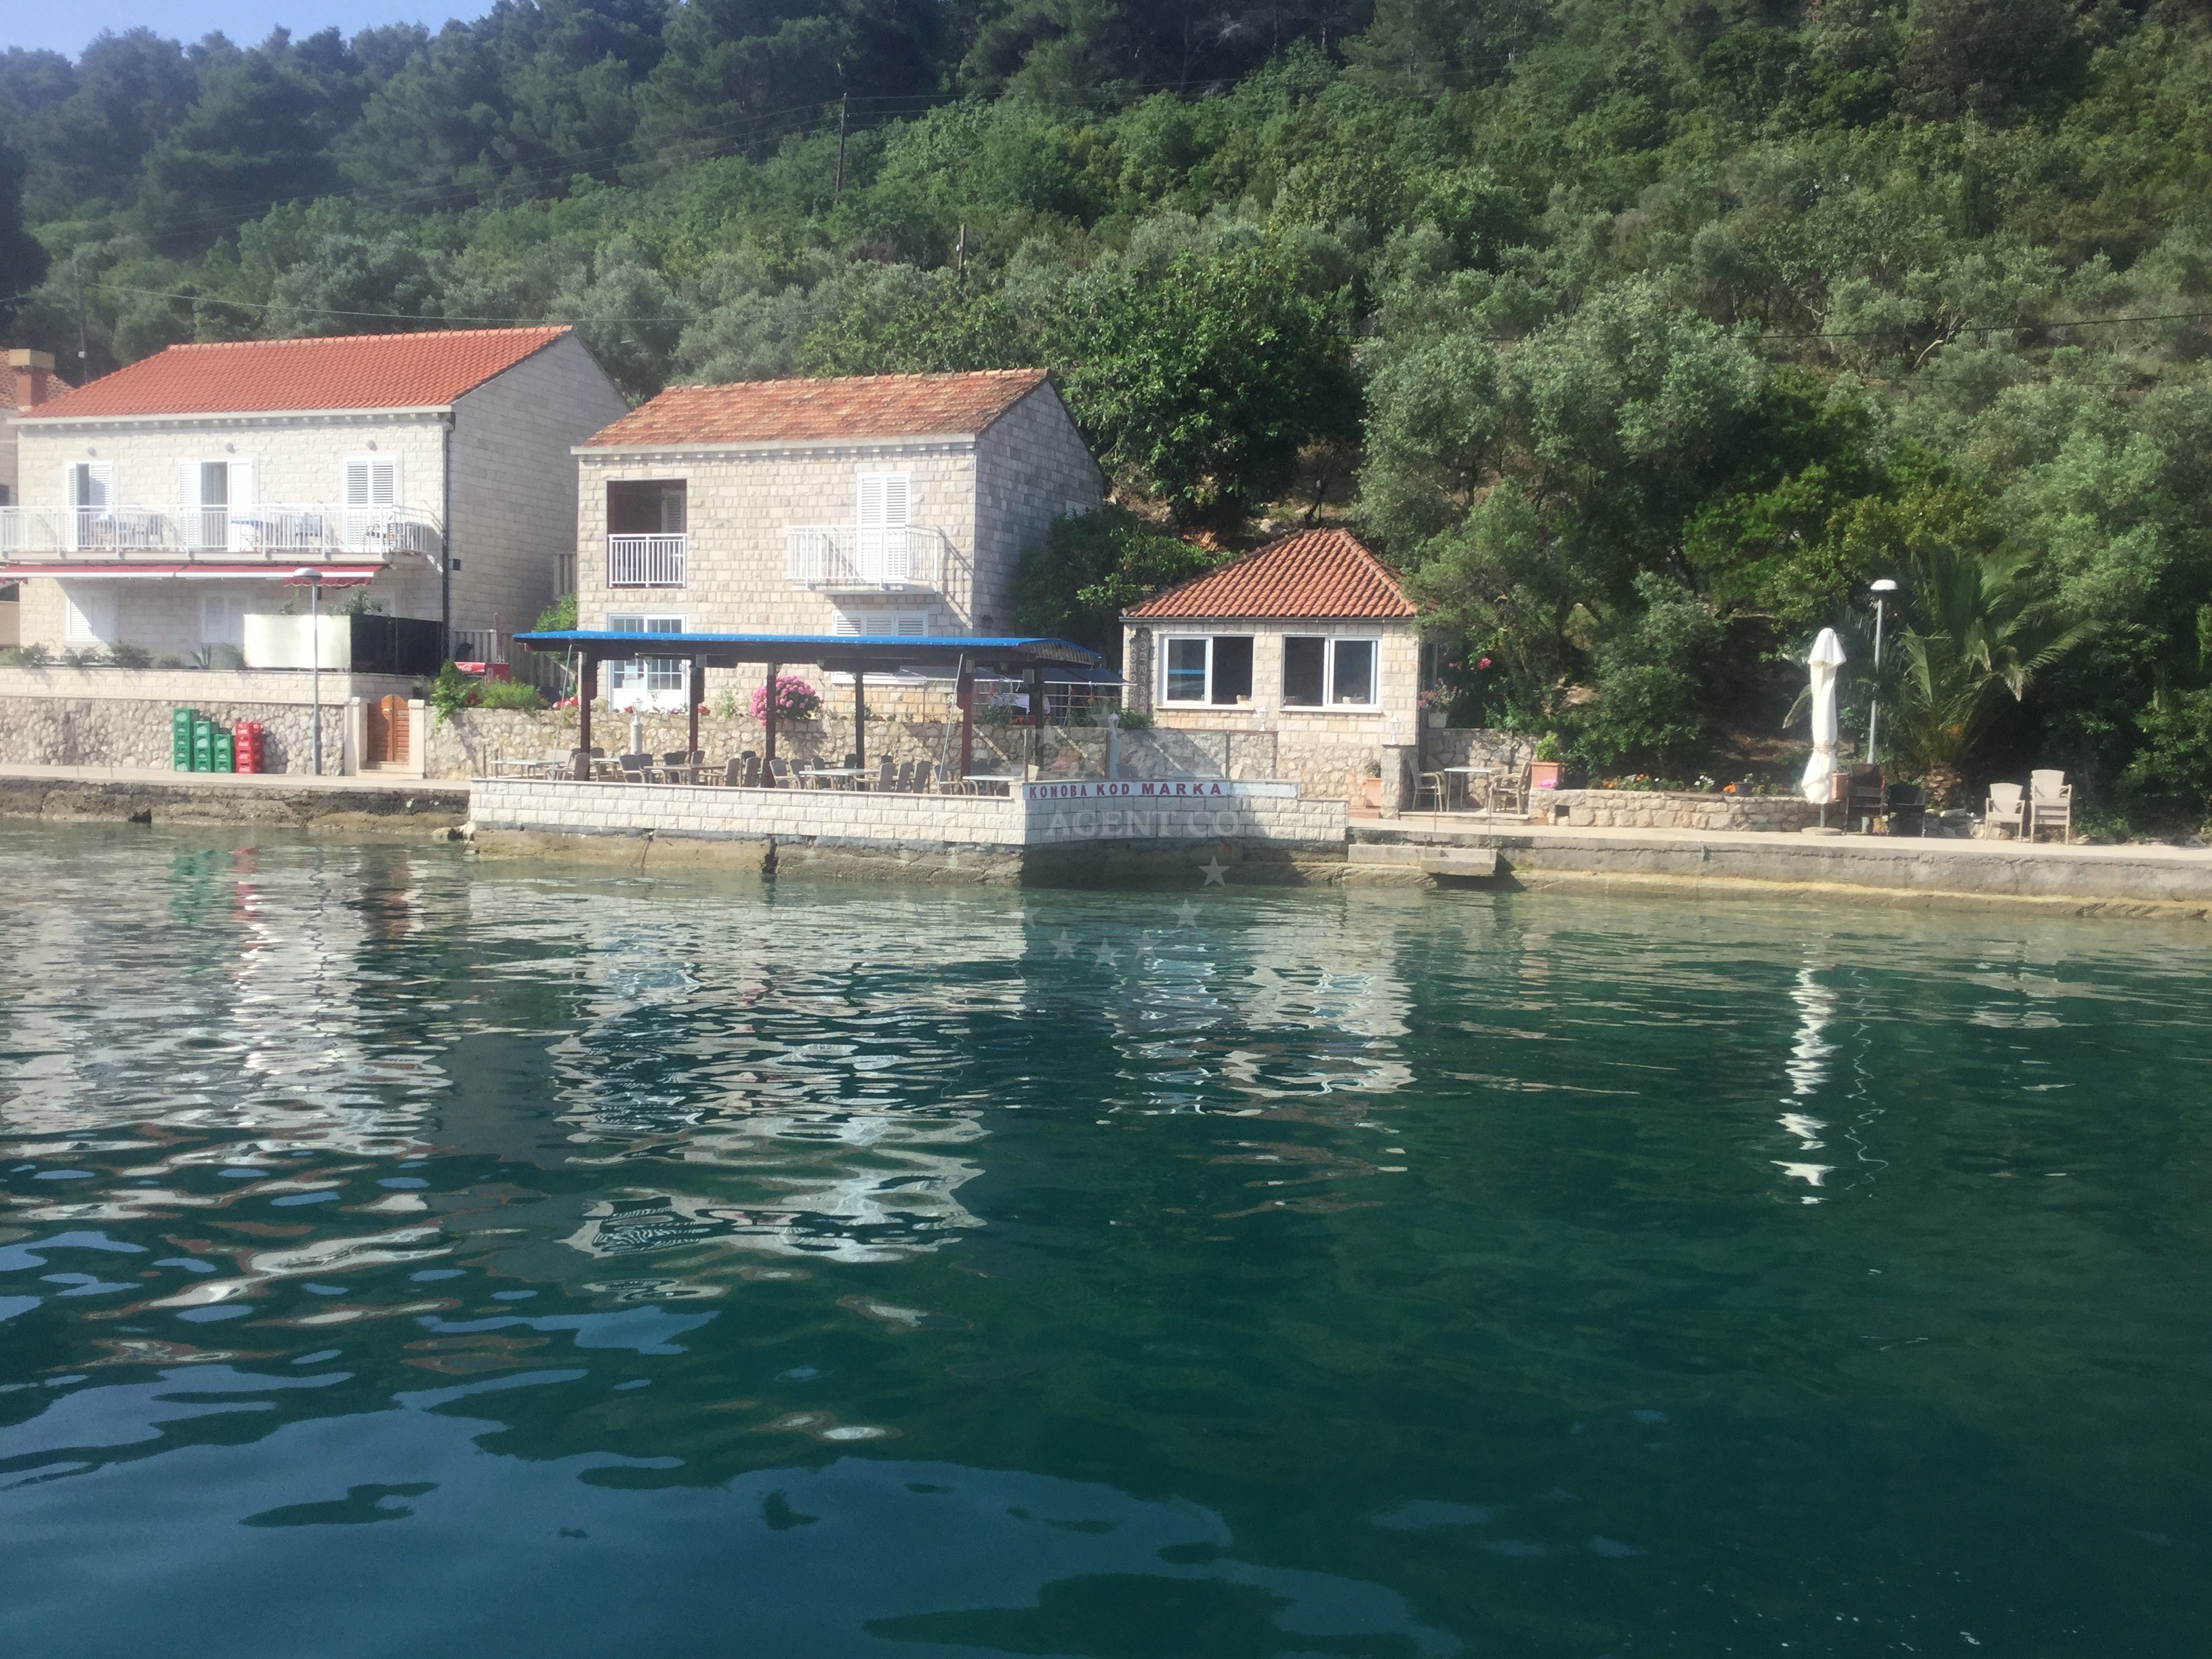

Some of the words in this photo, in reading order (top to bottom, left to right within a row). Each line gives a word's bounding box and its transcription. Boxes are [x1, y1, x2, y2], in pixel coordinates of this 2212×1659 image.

[1029, 784, 1088, 798] KONOBA
[1096, 783, 1130, 796] KOD
[1141, 782, 1222, 795] MARKA
